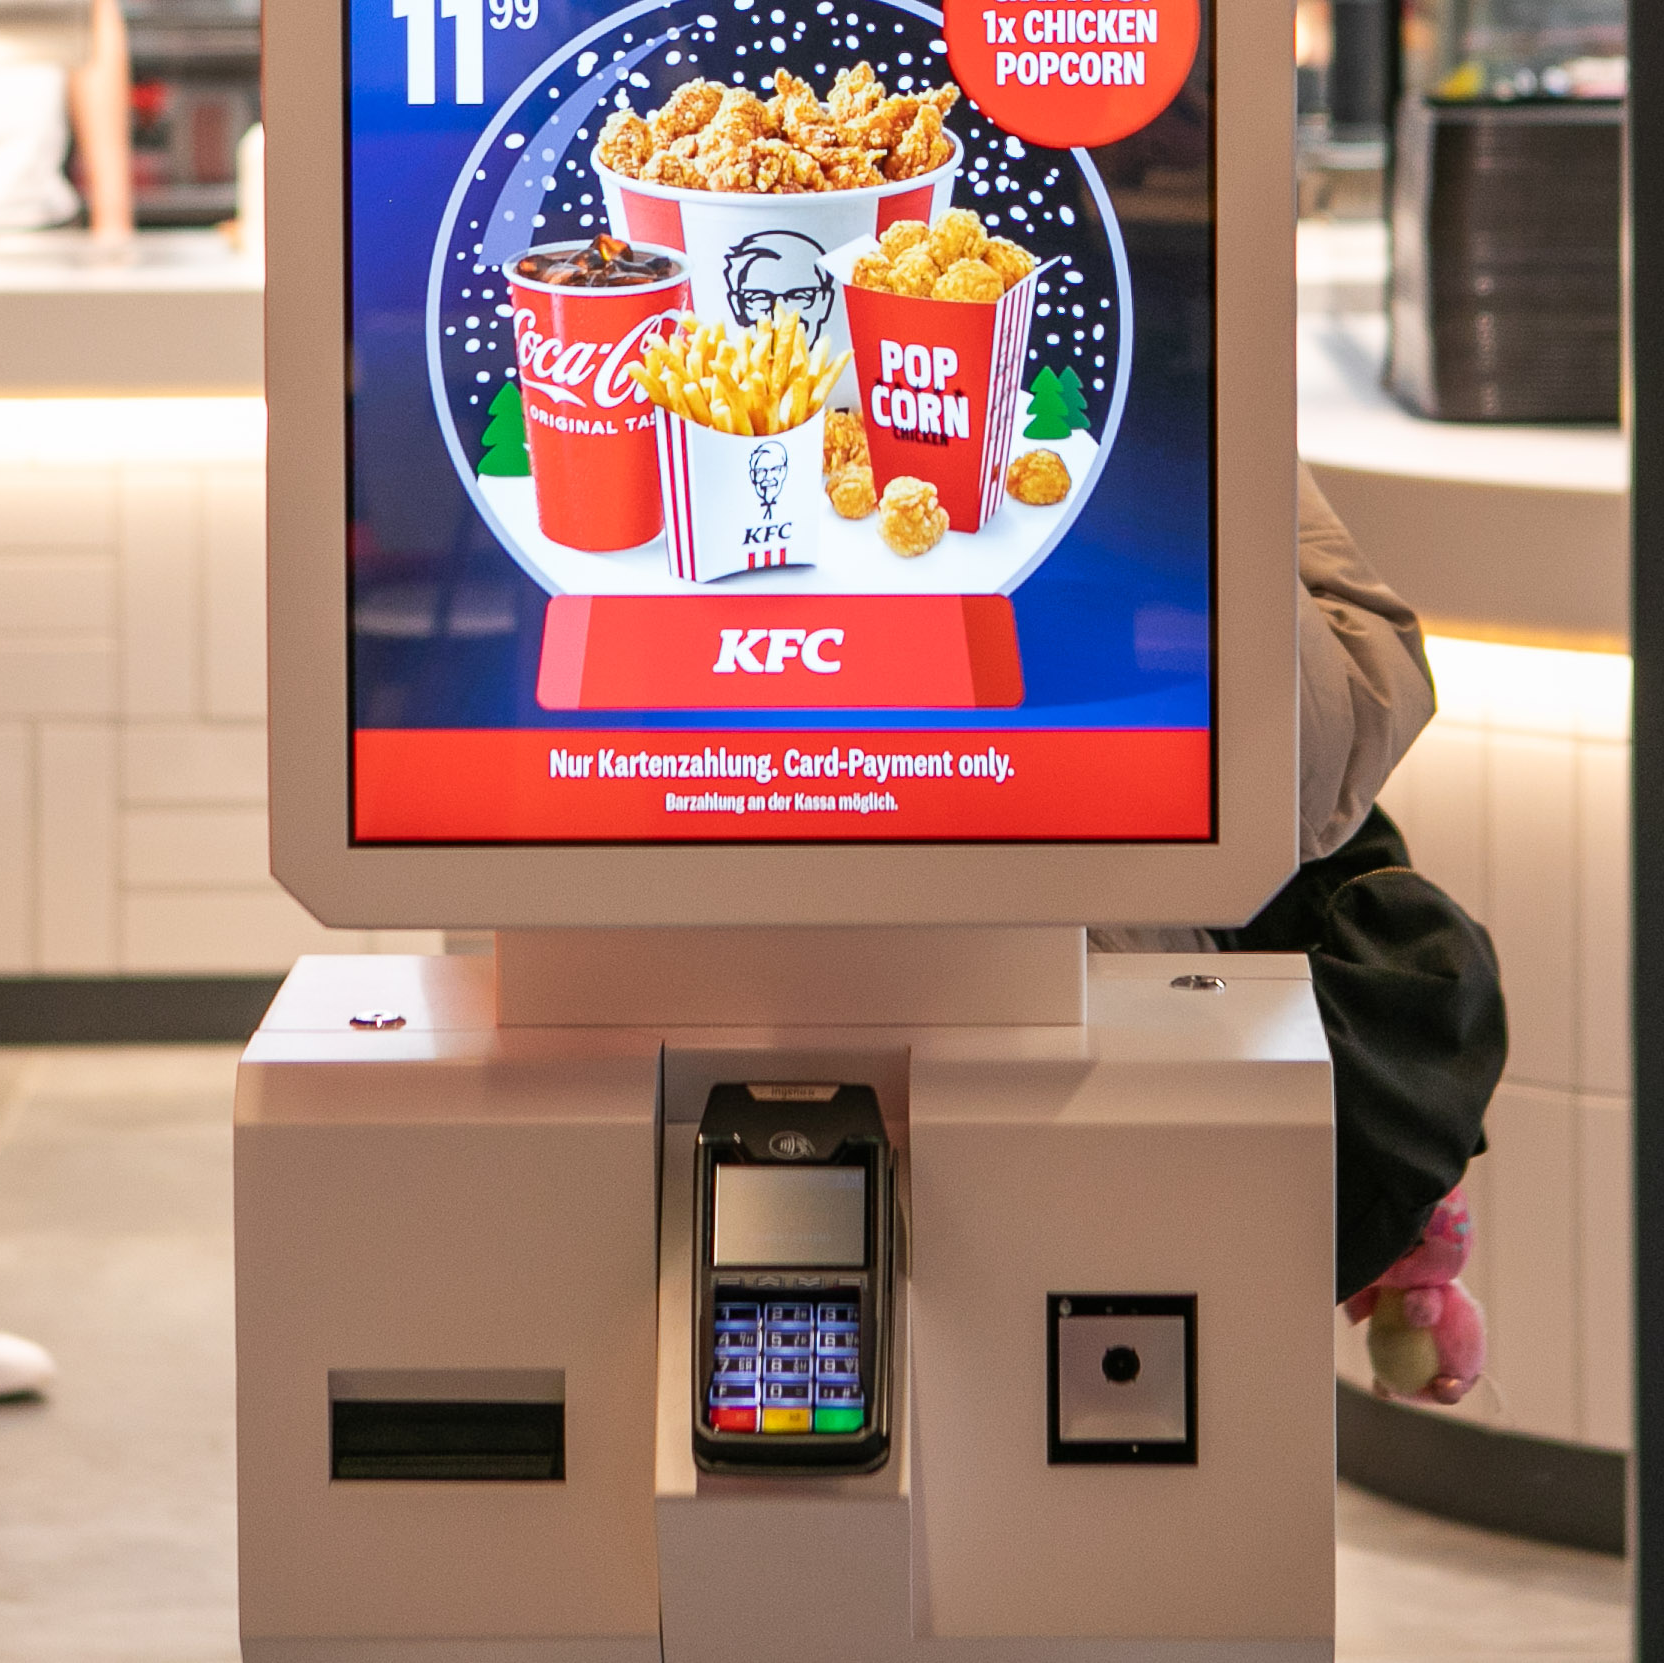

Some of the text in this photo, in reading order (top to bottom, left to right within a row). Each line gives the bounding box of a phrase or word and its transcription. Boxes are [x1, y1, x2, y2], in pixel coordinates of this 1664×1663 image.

[982, 8, 1158, 44] 1x CHICKEN
[996, 50, 1145, 86] POPCORN
[880, 339, 958, 392] POP
[529, 404, 618, 436] ORIGINAL
[871, 375, 970, 439] CORN
[741, 521, 792, 545] KFC
[712, 628, 845, 673] KFC
[549, 746, 1015, 784] Nur Kartenzahlung. Card-Payment only.
[665, 791, 899, 814] Barzahlung an der Kassa möglich.
